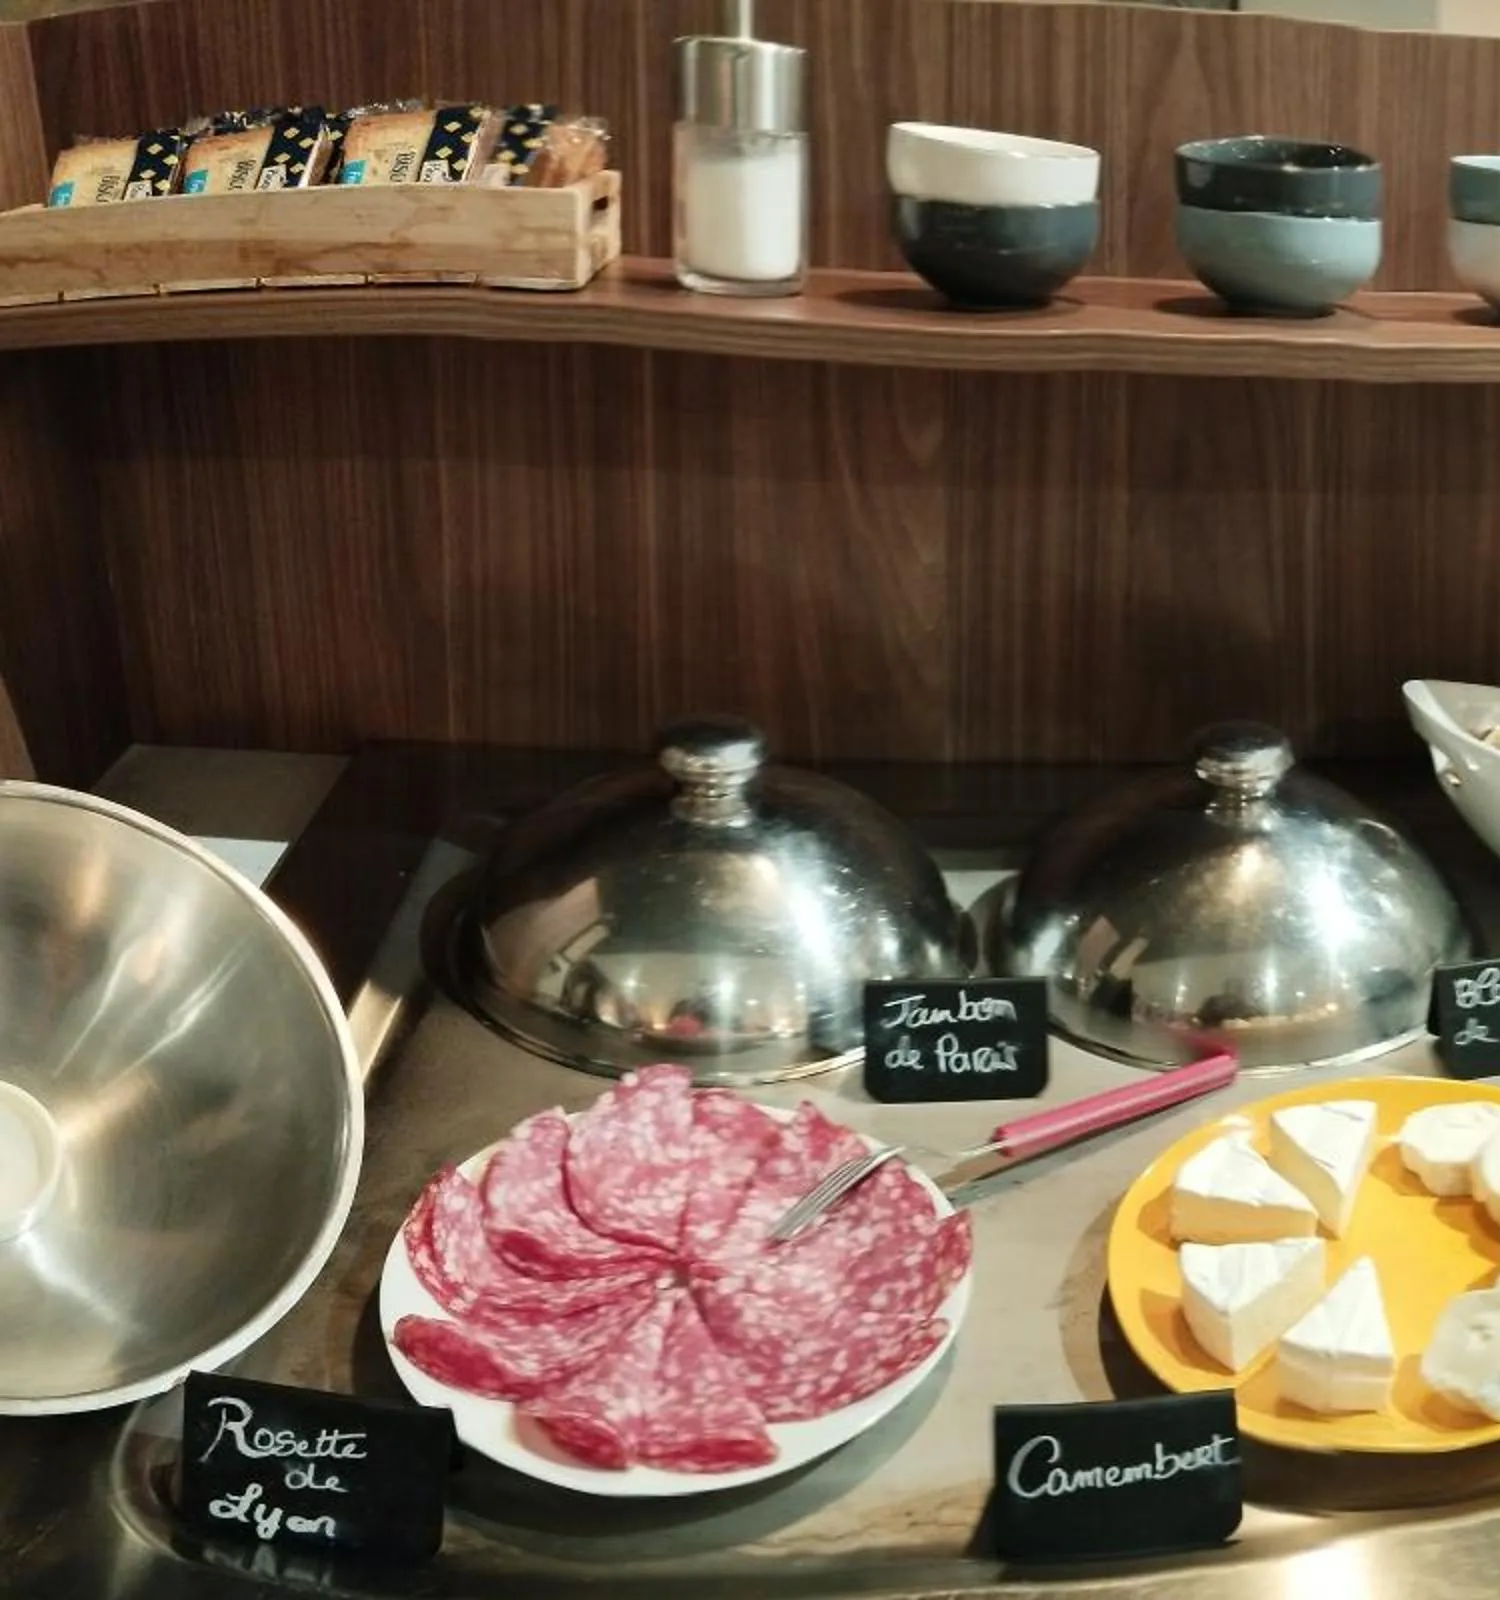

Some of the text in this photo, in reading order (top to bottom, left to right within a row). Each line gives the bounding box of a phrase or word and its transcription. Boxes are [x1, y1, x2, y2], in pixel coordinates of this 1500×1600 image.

[880, 989, 1017, 1029] Jambon
[884, 1033, 1018, 1073] de Paris
[200, 1396, 368, 1463] Rosette
[283, 1462, 349, 1492] de
[1007, 1434, 1242, 1498] Camembert
[209, 1482, 336, 1540] Lyon
